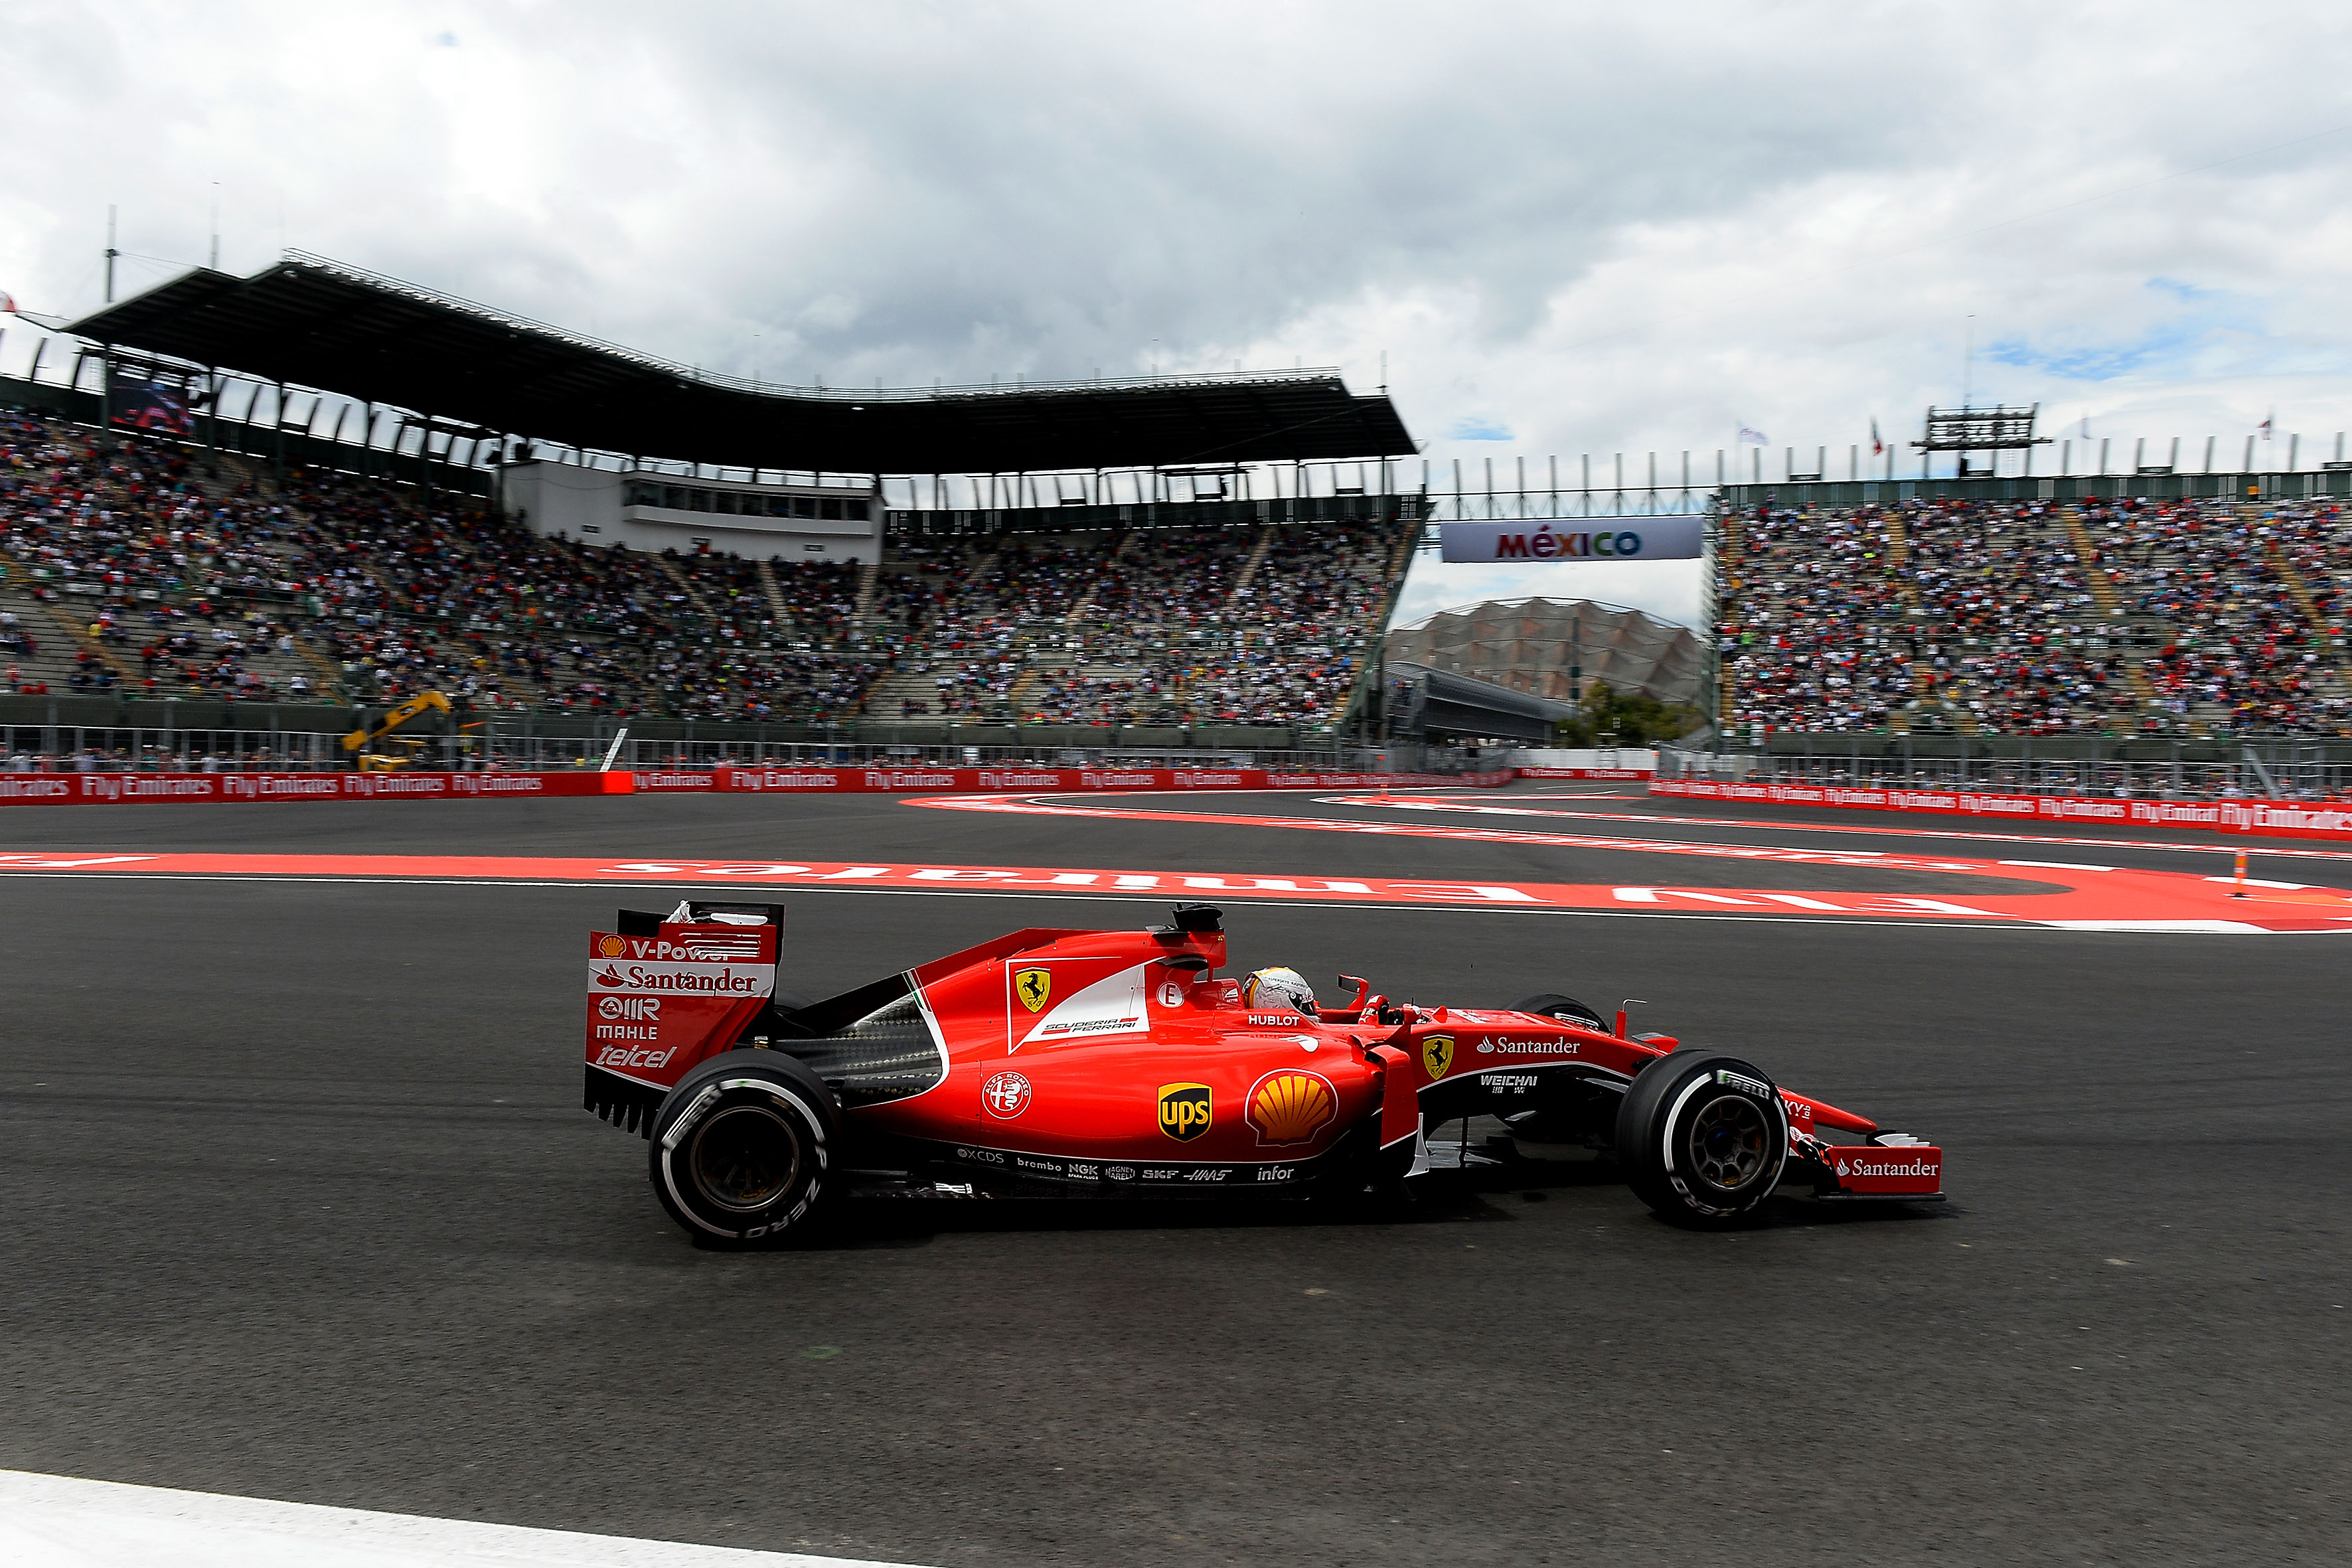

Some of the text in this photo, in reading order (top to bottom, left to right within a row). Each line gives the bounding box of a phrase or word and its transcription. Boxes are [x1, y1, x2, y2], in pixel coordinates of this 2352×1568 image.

[0, 776, 70, 797] irates
[81, 775, 213, 799] Fly Emirates
[223, 775, 339, 798] Fly Emirates
[344, 774, 445, 796] Fly Emirates
[452, 774, 542, 794] Fly Emirates
[632, 773, 713, 789] ly Emirates
[731, 771, 838, 790] Fly Emirates
[865, 771, 955, 789] Fly Emirates
[978, 771, 1060, 789] Fly Emirates
[1959, 795, 2036, 813] Fly Emirates
[2039, 799, 2126, 817] Fly Emirates
[2131, 803, 2220, 823] Fly Emirat
[2221, 803, 2254, 830] Fly
[627, 966, 757, 992] Santander
[1165, 984, 1176, 1005] E
[1044, 1019, 1119, 1030] SCUDERIA
[1072, 1022, 1136, 1033] FERRARI
[1248, 1014, 1300, 1026] HUBLOT
[597, 1025, 657, 1040] MAHLE
[1497, 1036, 1580, 1054] Santander
[985, 1073, 1029, 1096] ALFA ROMEO
[1481, 1075, 1538, 1086] WEICHAI
[1162, 1101, 1209, 1135] ups
[1801, 1105, 1811, 1120] lab
[1017, 1157, 1062, 1172] brembo
[1069, 1164, 1098, 1175] NGK
[1257, 1166, 1294, 1180] infor
[1852, 1158, 1938, 1176] Santander
[1142, 1170, 1179, 1179] SKF
